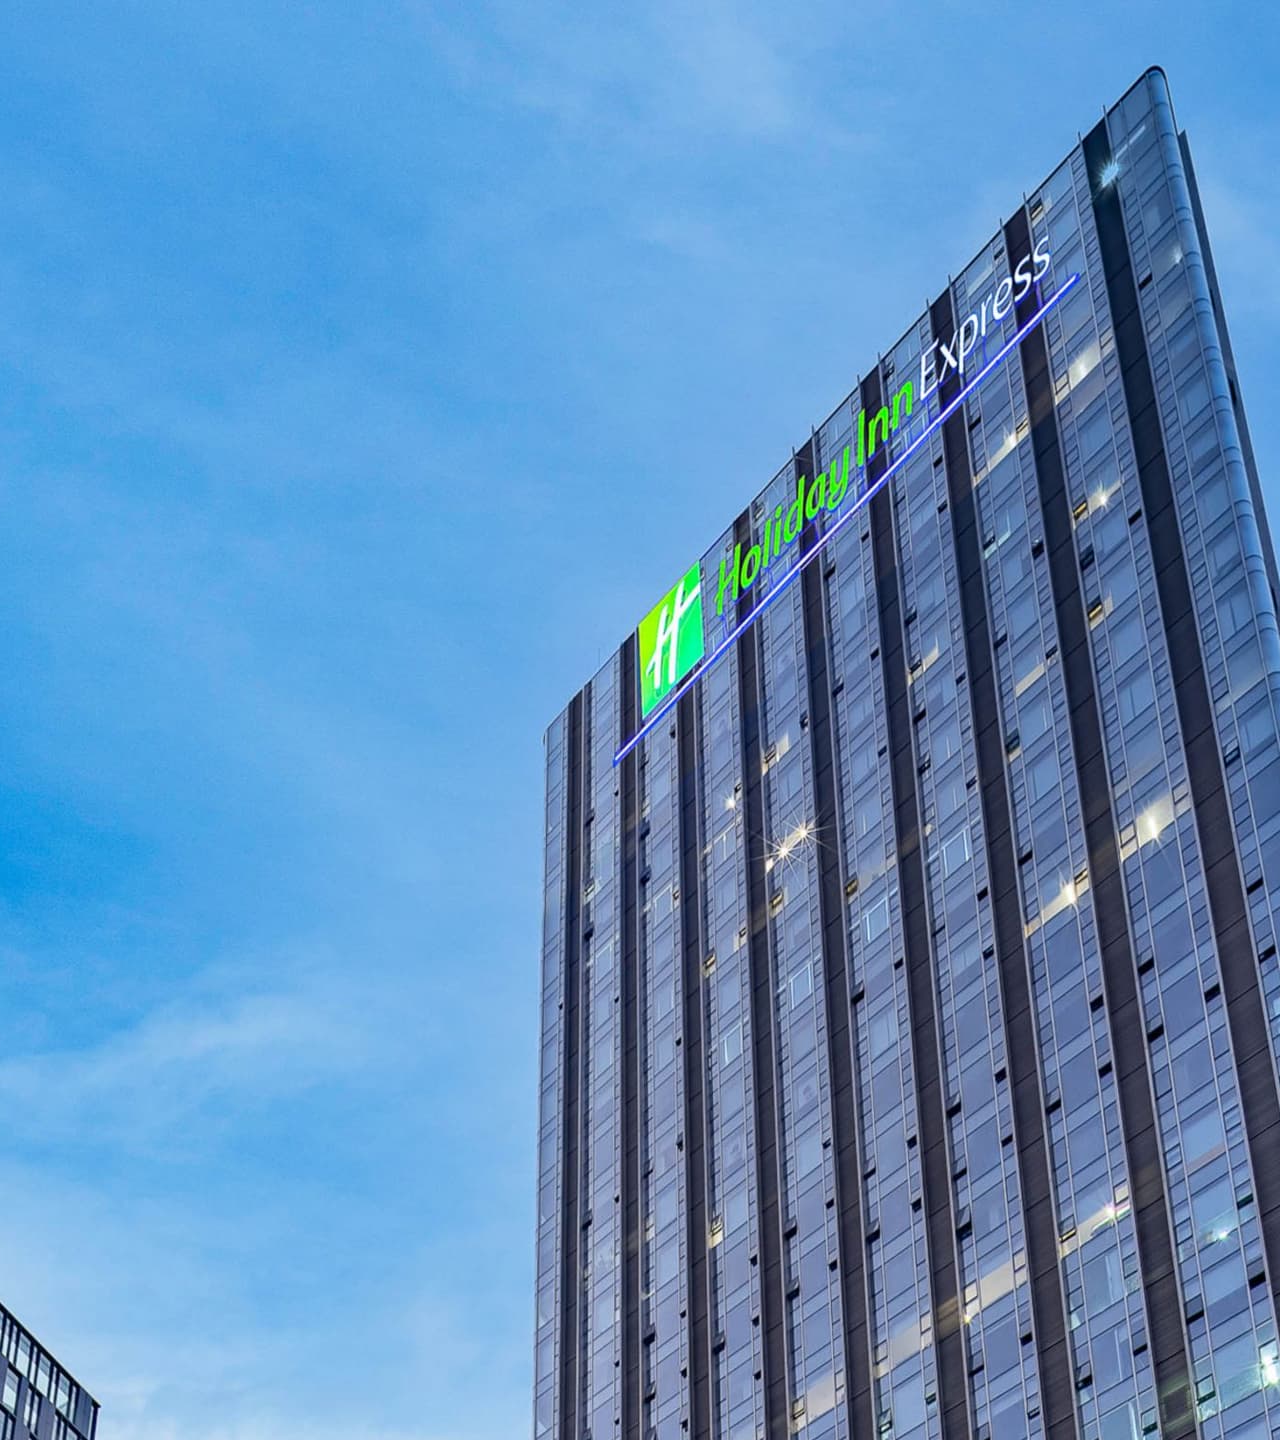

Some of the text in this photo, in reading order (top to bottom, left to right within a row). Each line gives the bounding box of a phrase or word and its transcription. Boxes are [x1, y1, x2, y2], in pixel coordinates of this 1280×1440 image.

[715, 236, 1051, 615] Holiday Inn Express
